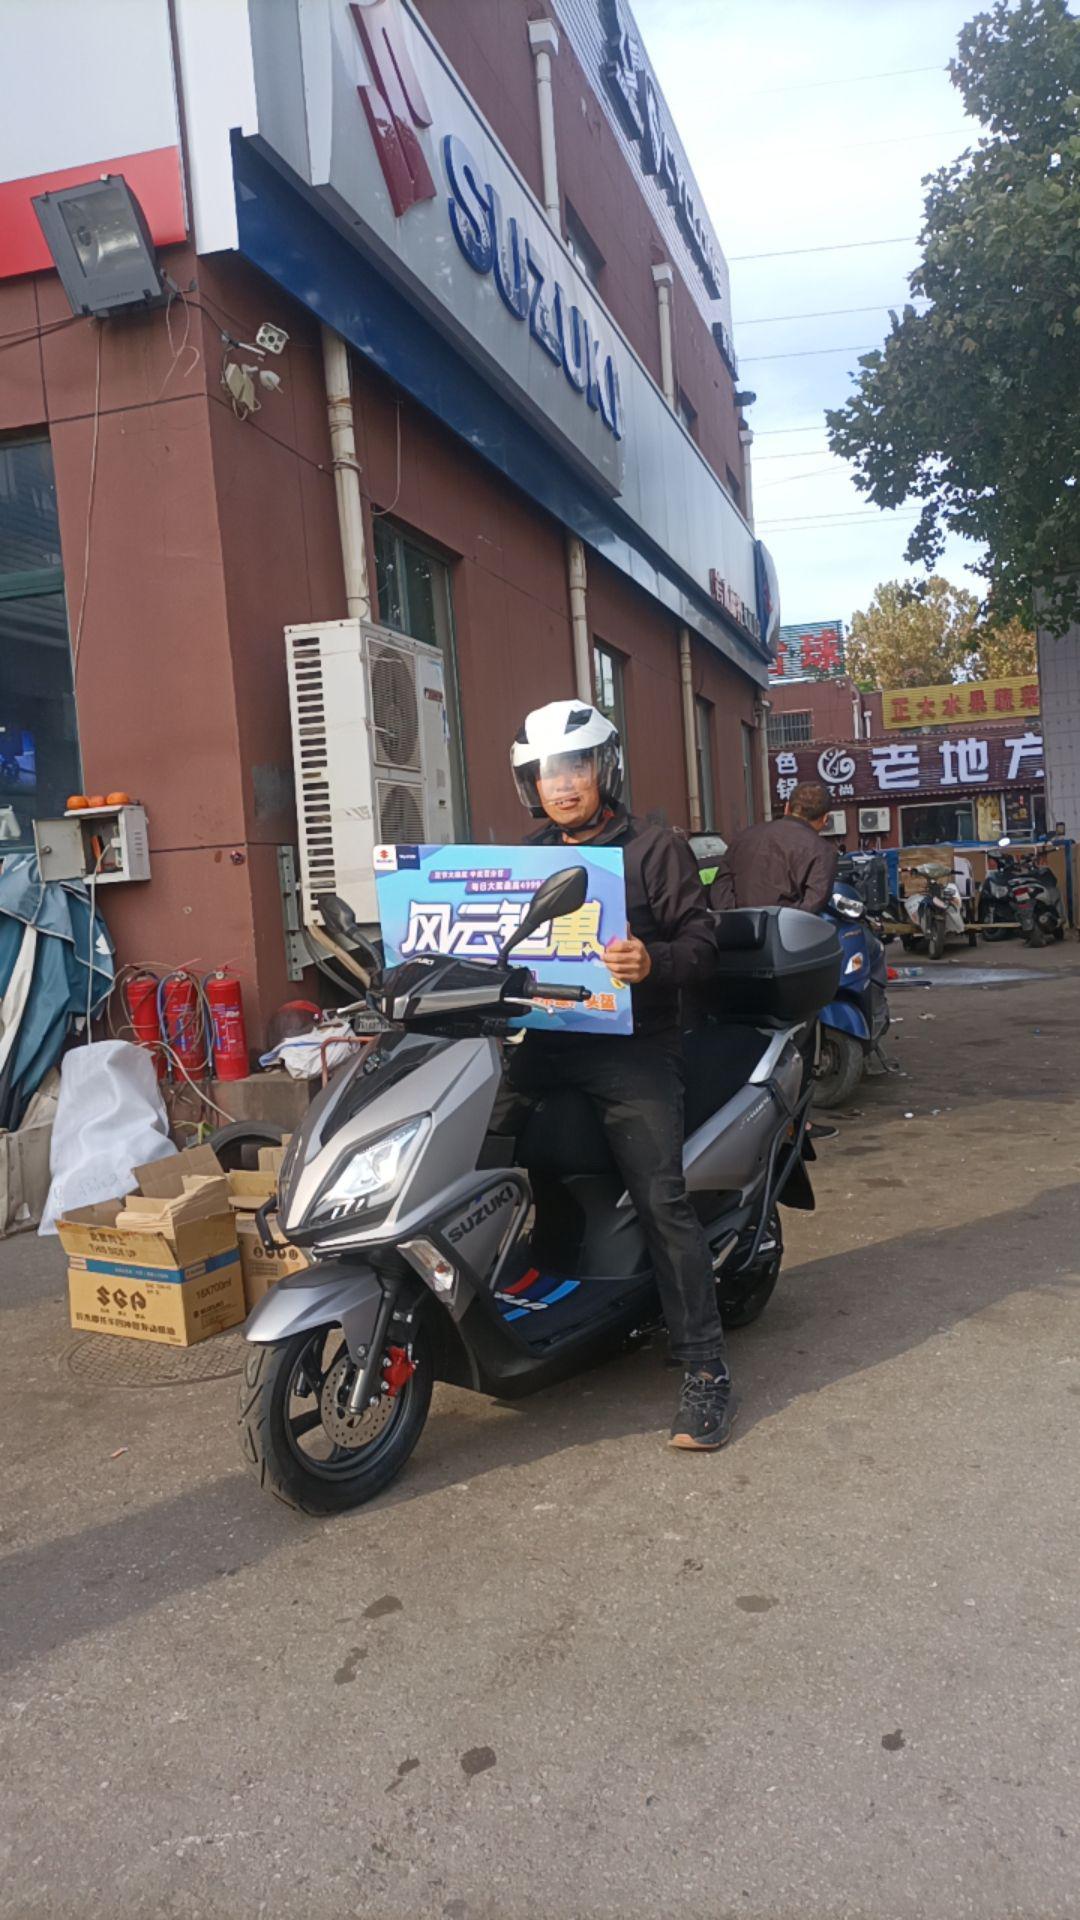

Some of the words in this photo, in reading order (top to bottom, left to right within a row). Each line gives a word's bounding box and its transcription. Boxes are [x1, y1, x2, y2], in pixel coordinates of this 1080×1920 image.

[441, 134, 622, 441] SUZUKI
[871, 732, 1044, 790] 老地方
[447, 1186, 514, 1243] SUZUKI
